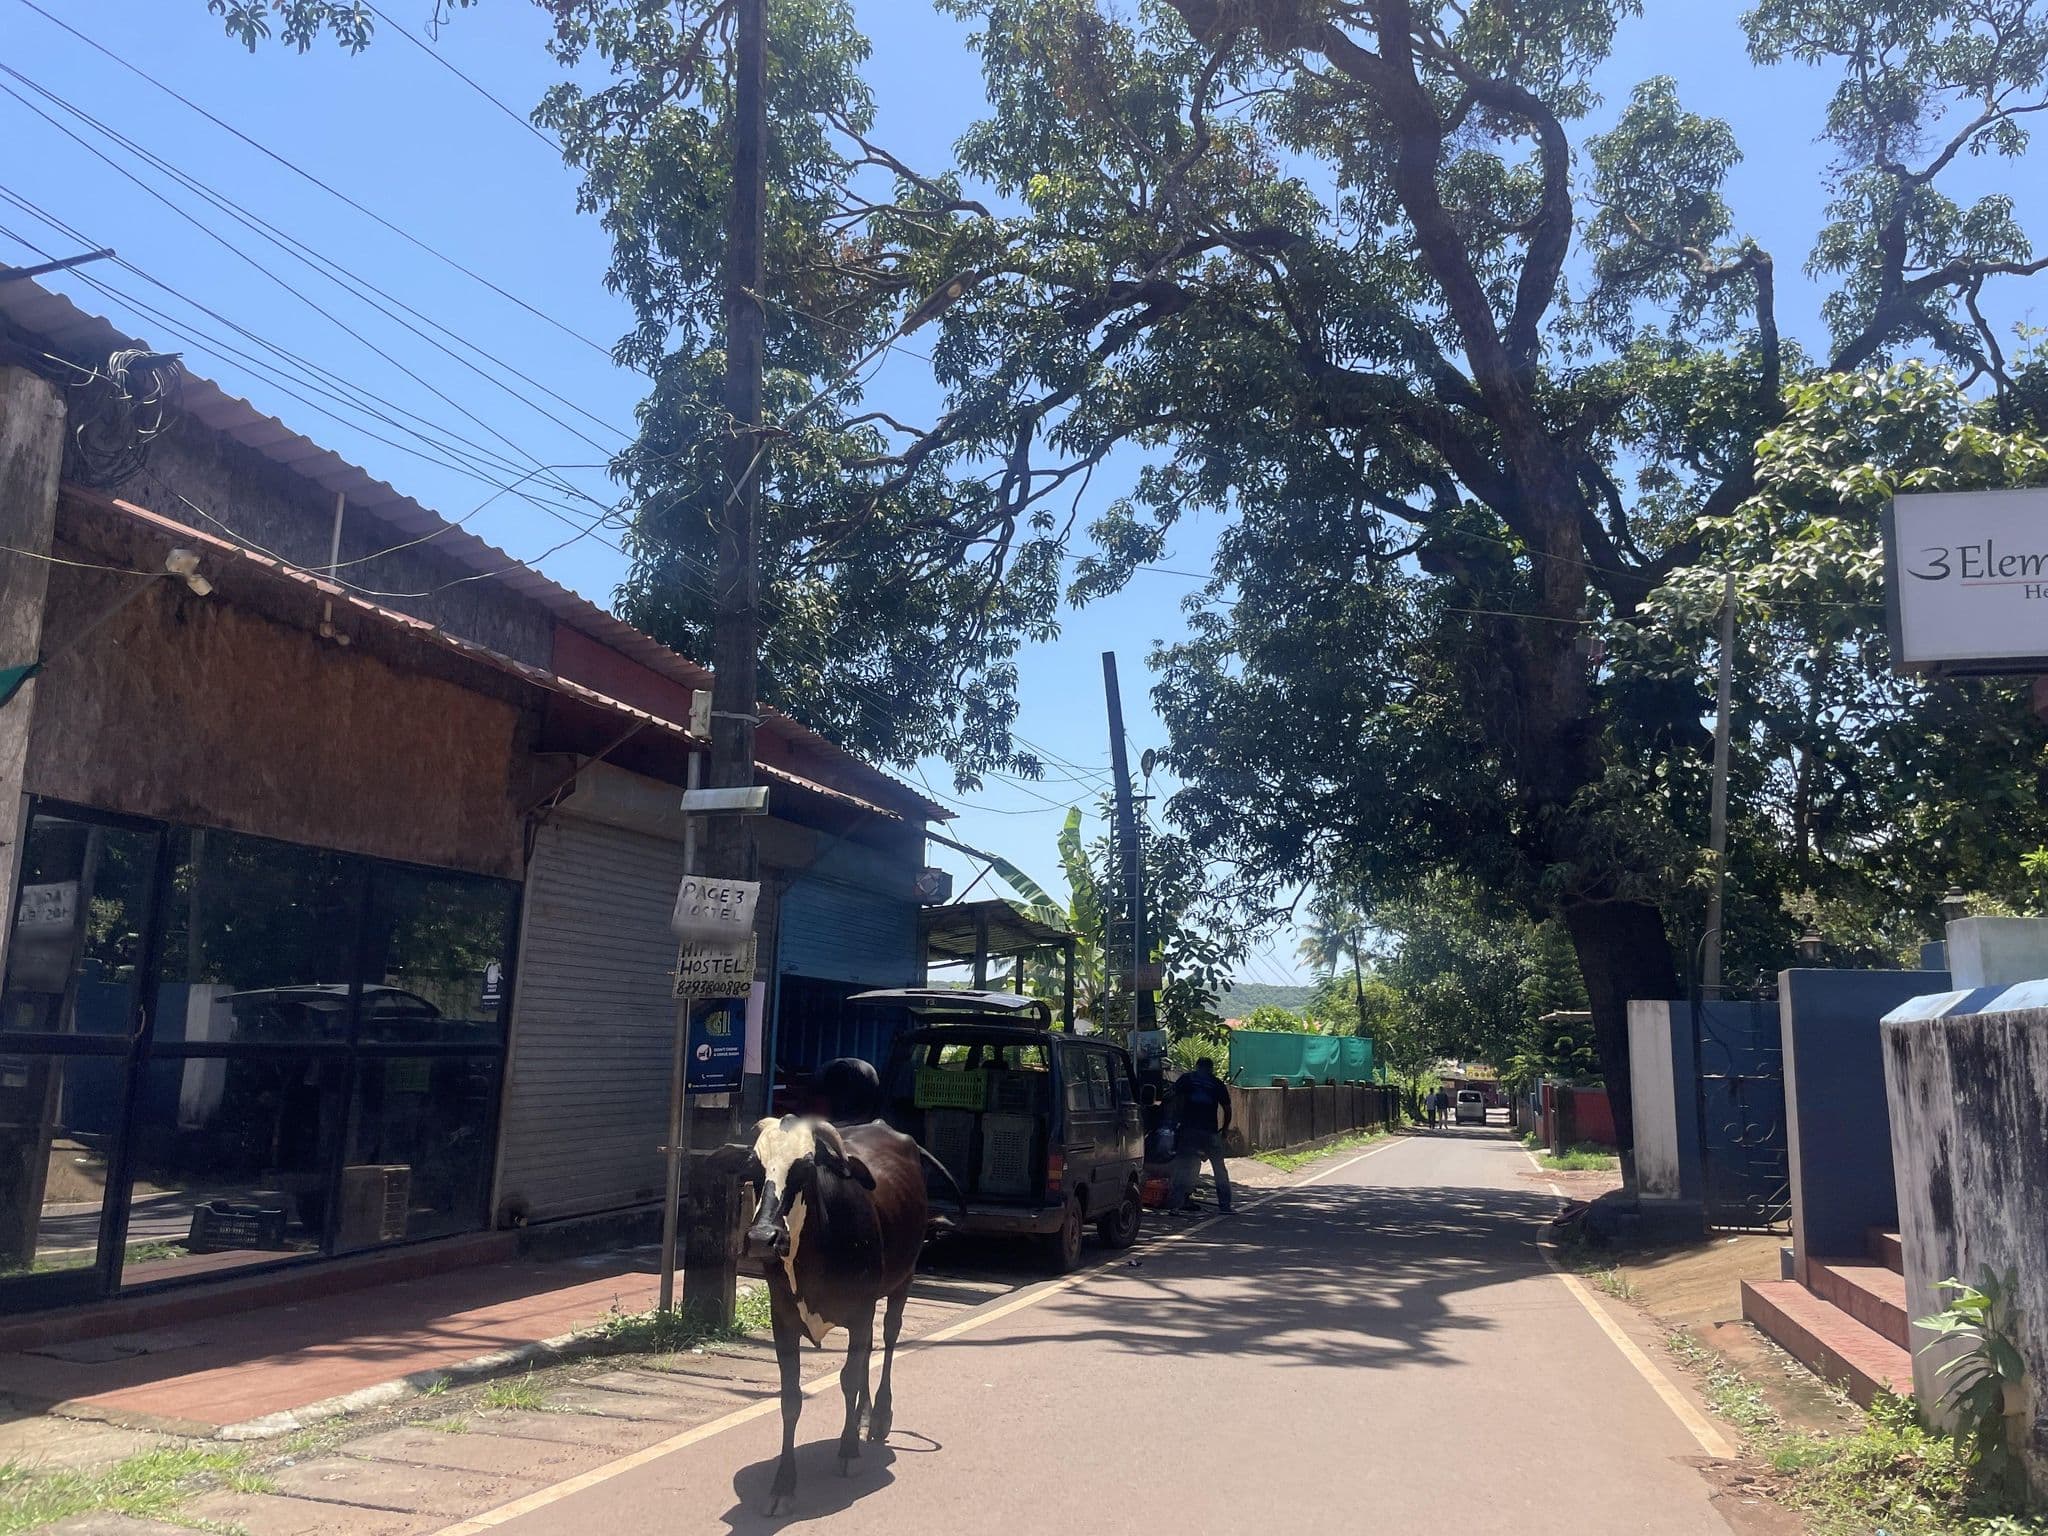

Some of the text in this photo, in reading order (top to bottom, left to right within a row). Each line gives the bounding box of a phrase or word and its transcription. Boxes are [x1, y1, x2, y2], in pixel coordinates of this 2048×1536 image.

[683, 882, 745, 904] PAGE 3
[680, 958, 745, 975] HOSTEL
